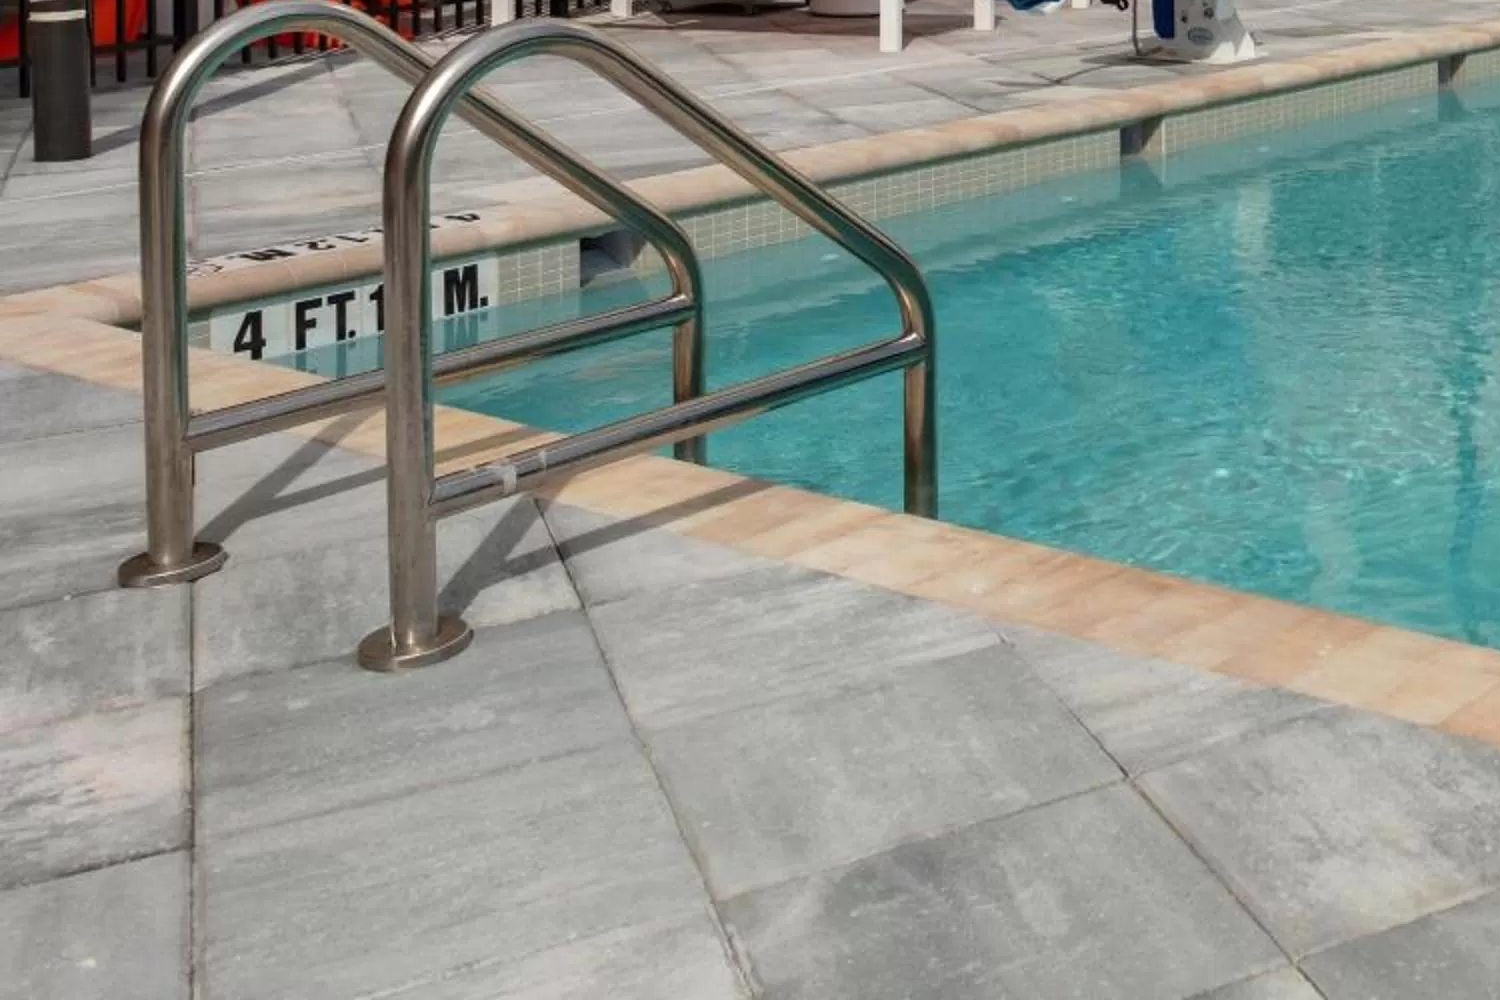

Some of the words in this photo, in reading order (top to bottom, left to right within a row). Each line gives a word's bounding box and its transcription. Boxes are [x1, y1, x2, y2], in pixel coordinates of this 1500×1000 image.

[234, 310, 267, 360] 4
[295, 291, 357, 350] FT.
[443, 264, 489, 316] M.
